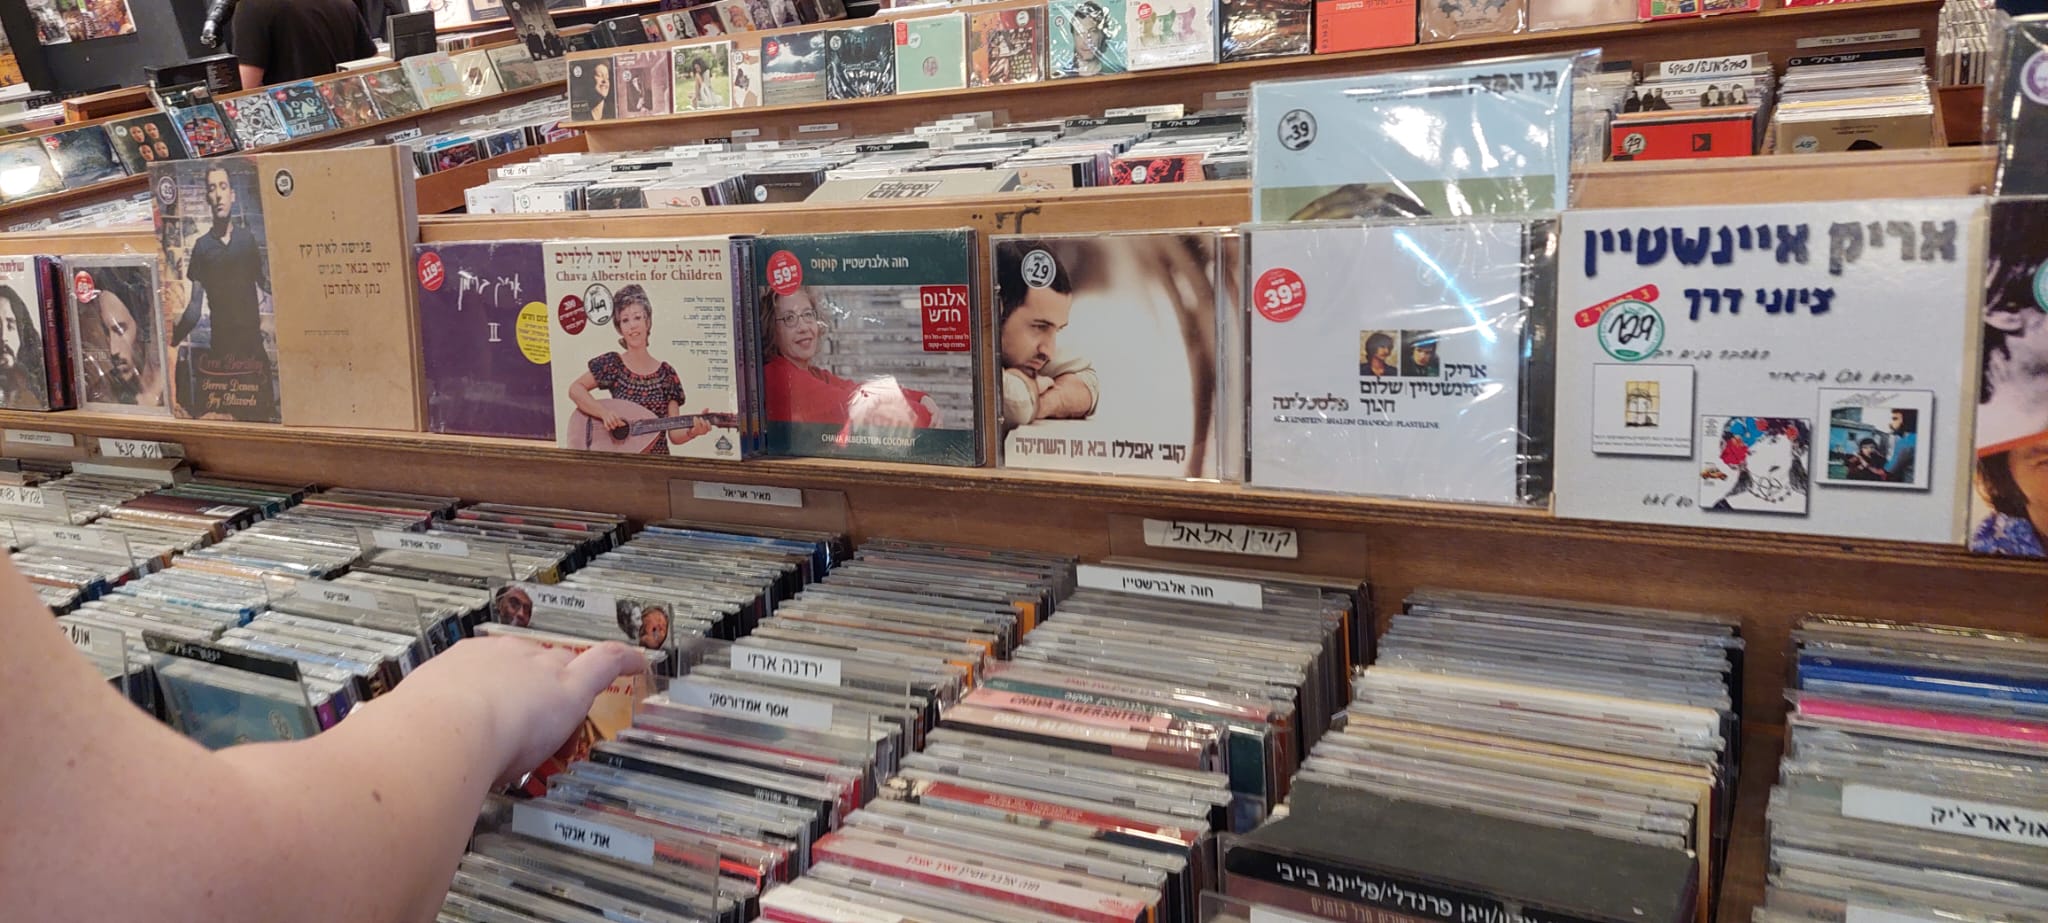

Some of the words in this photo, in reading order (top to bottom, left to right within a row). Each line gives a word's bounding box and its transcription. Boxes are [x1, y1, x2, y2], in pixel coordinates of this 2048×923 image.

[299, 243, 313, 258] קץ
[316, 239, 338, 257] לאין
[341, 241, 372, 254] פגישה
[1585, 224, 1810, 279] איינשטיין
[1829, 219, 1957, 276] אריק
[346, 262, 369, 274] בנאי
[372, 261, 391, 273] יוסי
[811, 258, 838, 272] קוקוס
[842, 253, 890, 272] אלברשטיין
[892, 256, 909, 268] חוה
[556, 271, 588, 282] Chava
[591, 269, 647, 282] Alberstein
[650, 269, 667, 281] for
[671, 267, 723, 281] Children
[323, 279, 362, 299] אלתרמן
[365, 283, 381, 298] נתן
[923, 287, 967, 307] אלבום
[1684, 287, 1744, 321] דרך
[1756, 287, 1836, 315] ציוני
[928, 308, 961, 323] חדש
[1444, 363, 1488, 381] אריק
[1360, 376, 1403, 394] שלום
[1360, 397, 1396, 415] חנוך
[1015, 437, 1067, 457] השתיקה
[1070, 439, 1084, 458] מן
[1088, 440, 1107, 457] בא
[1112, 439, 1154, 460] אפללו
[1158, 443, 1186, 464] קובי
[722, 486, 748, 499] אריאל
[752, 490, 771, 501] מאיר
[1121, 574, 1186, 596] אלברשטיין
[1190, 584, 1214, 599] חוה
[537, 592, 558, 606] ארצי
[560, 594, 585, 609] שלמה
[747, 651, 778, 671] ארזי
[782, 658, 823, 678] ירדנה
[709, 691, 762, 713] אמדורסקי
[764, 701, 789, 718] אסף
[554, 820, 586, 844] אנקרי
[1276, 861, 1320, 888] בייבי
